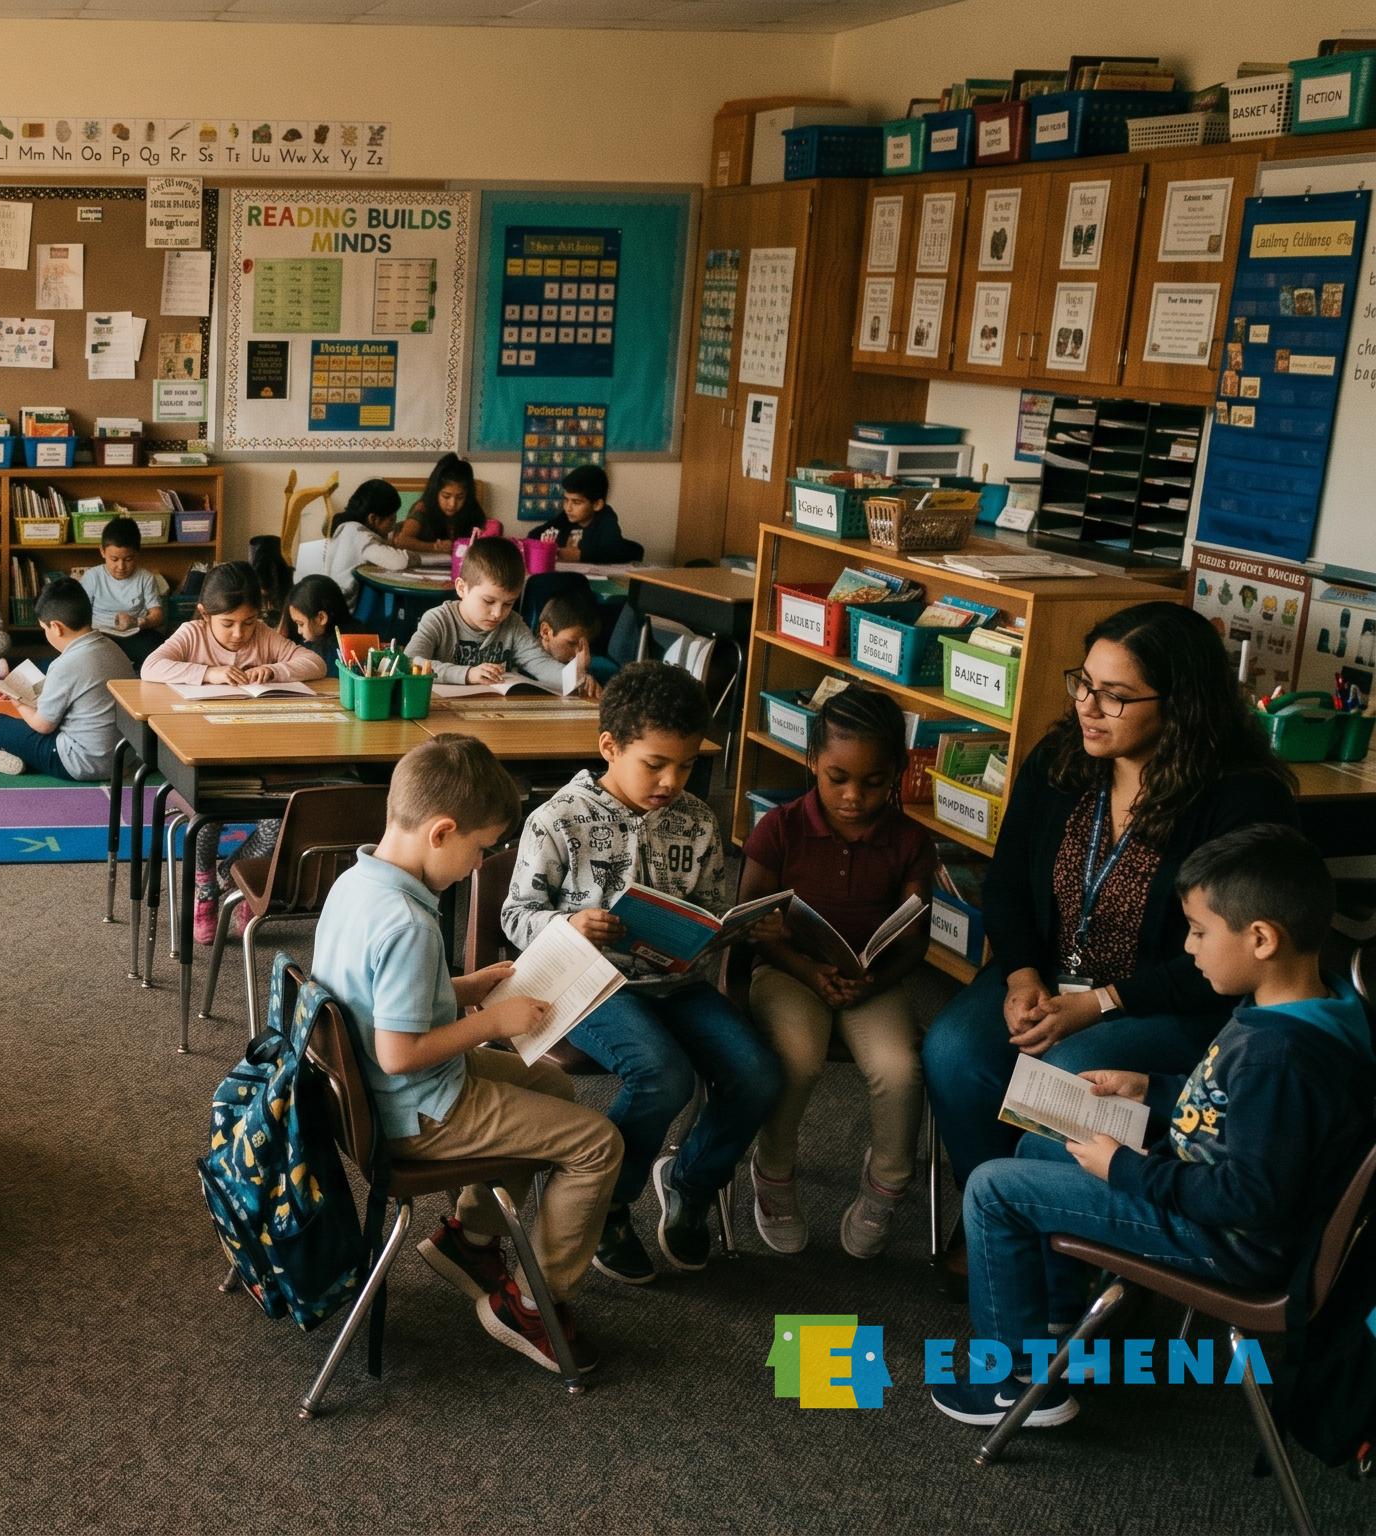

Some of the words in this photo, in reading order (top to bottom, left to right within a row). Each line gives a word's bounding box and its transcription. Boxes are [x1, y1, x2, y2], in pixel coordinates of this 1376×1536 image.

[1306, 90, 1342, 104] FICTION
[1233, 104, 1268, 119] BASKET
[1270, 103, 1276, 114] 4
[20, 146, 45, 161] Mm
[53, 146, 72, 162] Nn
[81, 146, 102, 162] Oo
[112, 147, 130, 167] Pp
[171, 147, 187, 162] Rr
[199, 147, 213, 162] Ss
[252, 148, 270, 163] Uu
[279, 150, 307, 164] Ww
[312, 149, 330, 164] Xx
[341, 150, 357, 170] Yy
[248, 206, 357, 227] READING
[368, 208, 452, 229] BUILDS
[312, 232, 391, 253] MINDS
[994, 679, 1000, 691] 4
[12, 836, 61, 852] K
